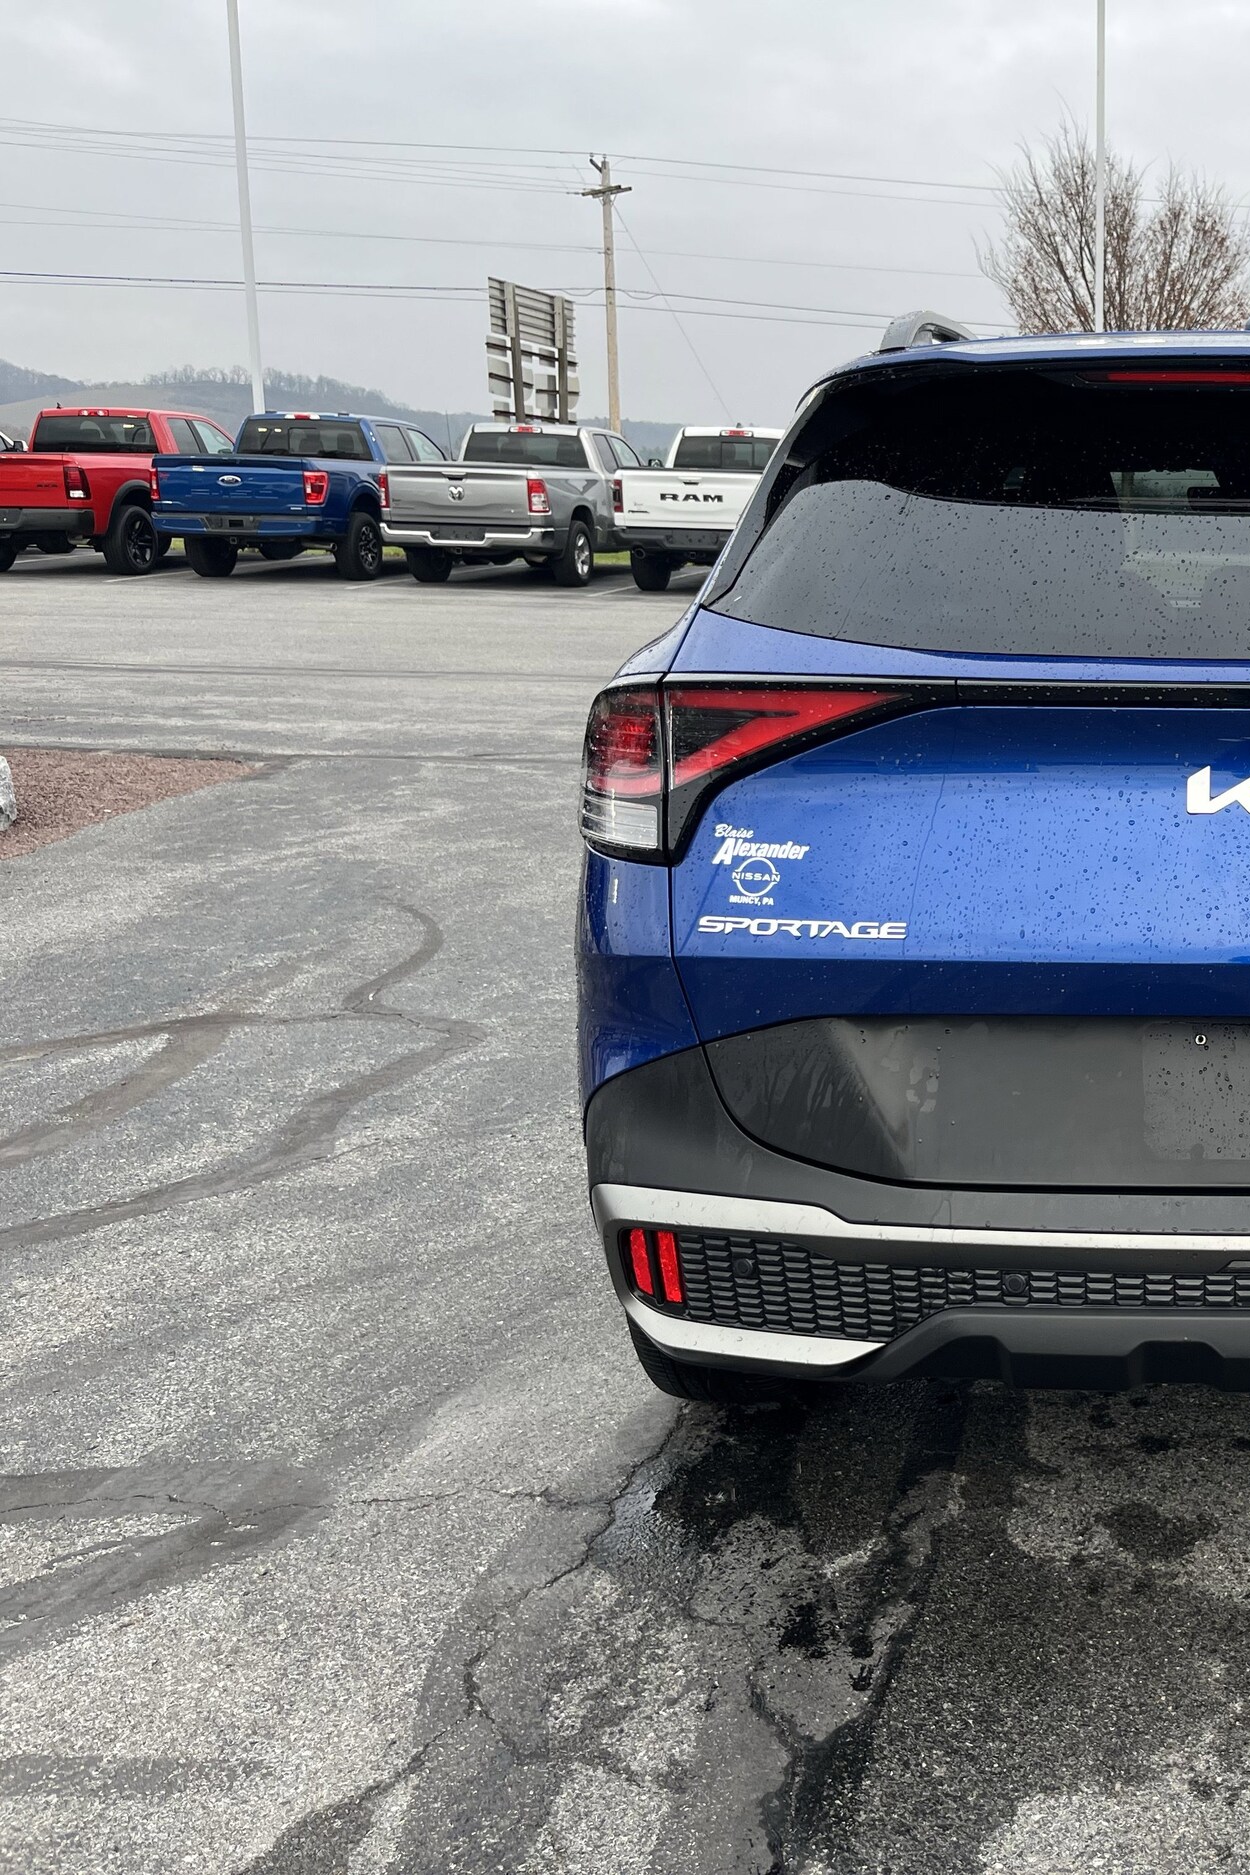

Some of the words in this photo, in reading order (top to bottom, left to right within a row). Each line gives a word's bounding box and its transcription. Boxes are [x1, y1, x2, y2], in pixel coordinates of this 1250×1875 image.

[660, 493, 723, 502] RAM
[715, 823, 754, 838] Blaise
[712, 838, 810, 865] Alexander
[732, 871, 780, 882] NISSAN
[729, 895, 761, 906] MUNCY,
[762, 898, 774, 906] PA
[698, 916, 907, 939] SPORTAGE
